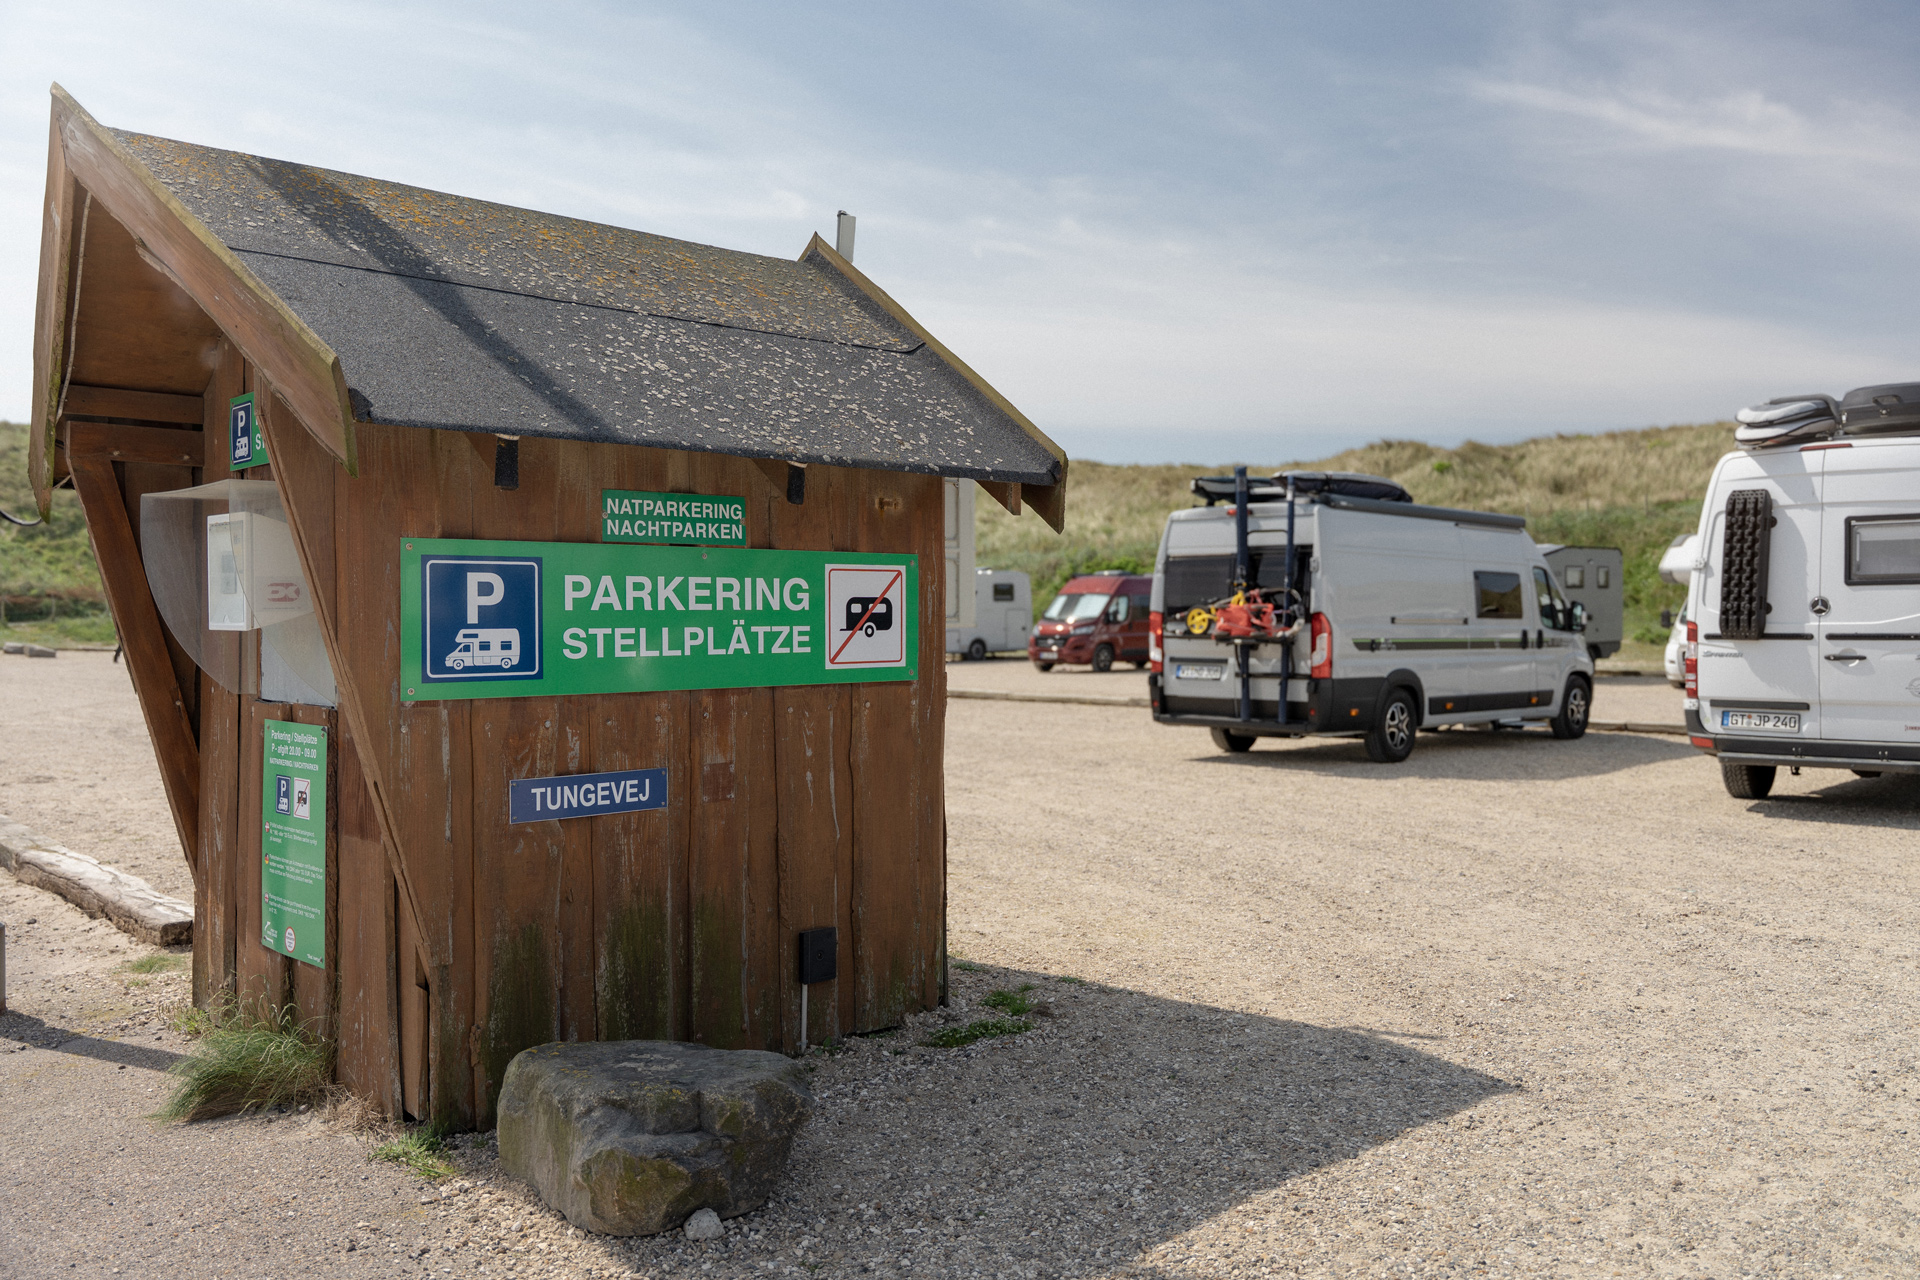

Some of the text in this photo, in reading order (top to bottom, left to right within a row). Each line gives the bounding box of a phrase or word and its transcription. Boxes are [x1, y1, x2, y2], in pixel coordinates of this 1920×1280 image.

[238, 410, 246, 437] P
[606, 499, 743, 519] NATPARKERING
[606, 519, 743, 540] NACHTPARKEN
[466, 571, 504, 623] P
[564, 574, 810, 611] PARKERING
[562, 620, 811, 660] STELLPLÄTZE
[1730, 713, 1797, 728] GT JP 240
[271, 730, 291, 743] Parkering
[294, 732, 317, 744] Stellplätze
[531, 778, 650, 811] TUNGEVEJ
